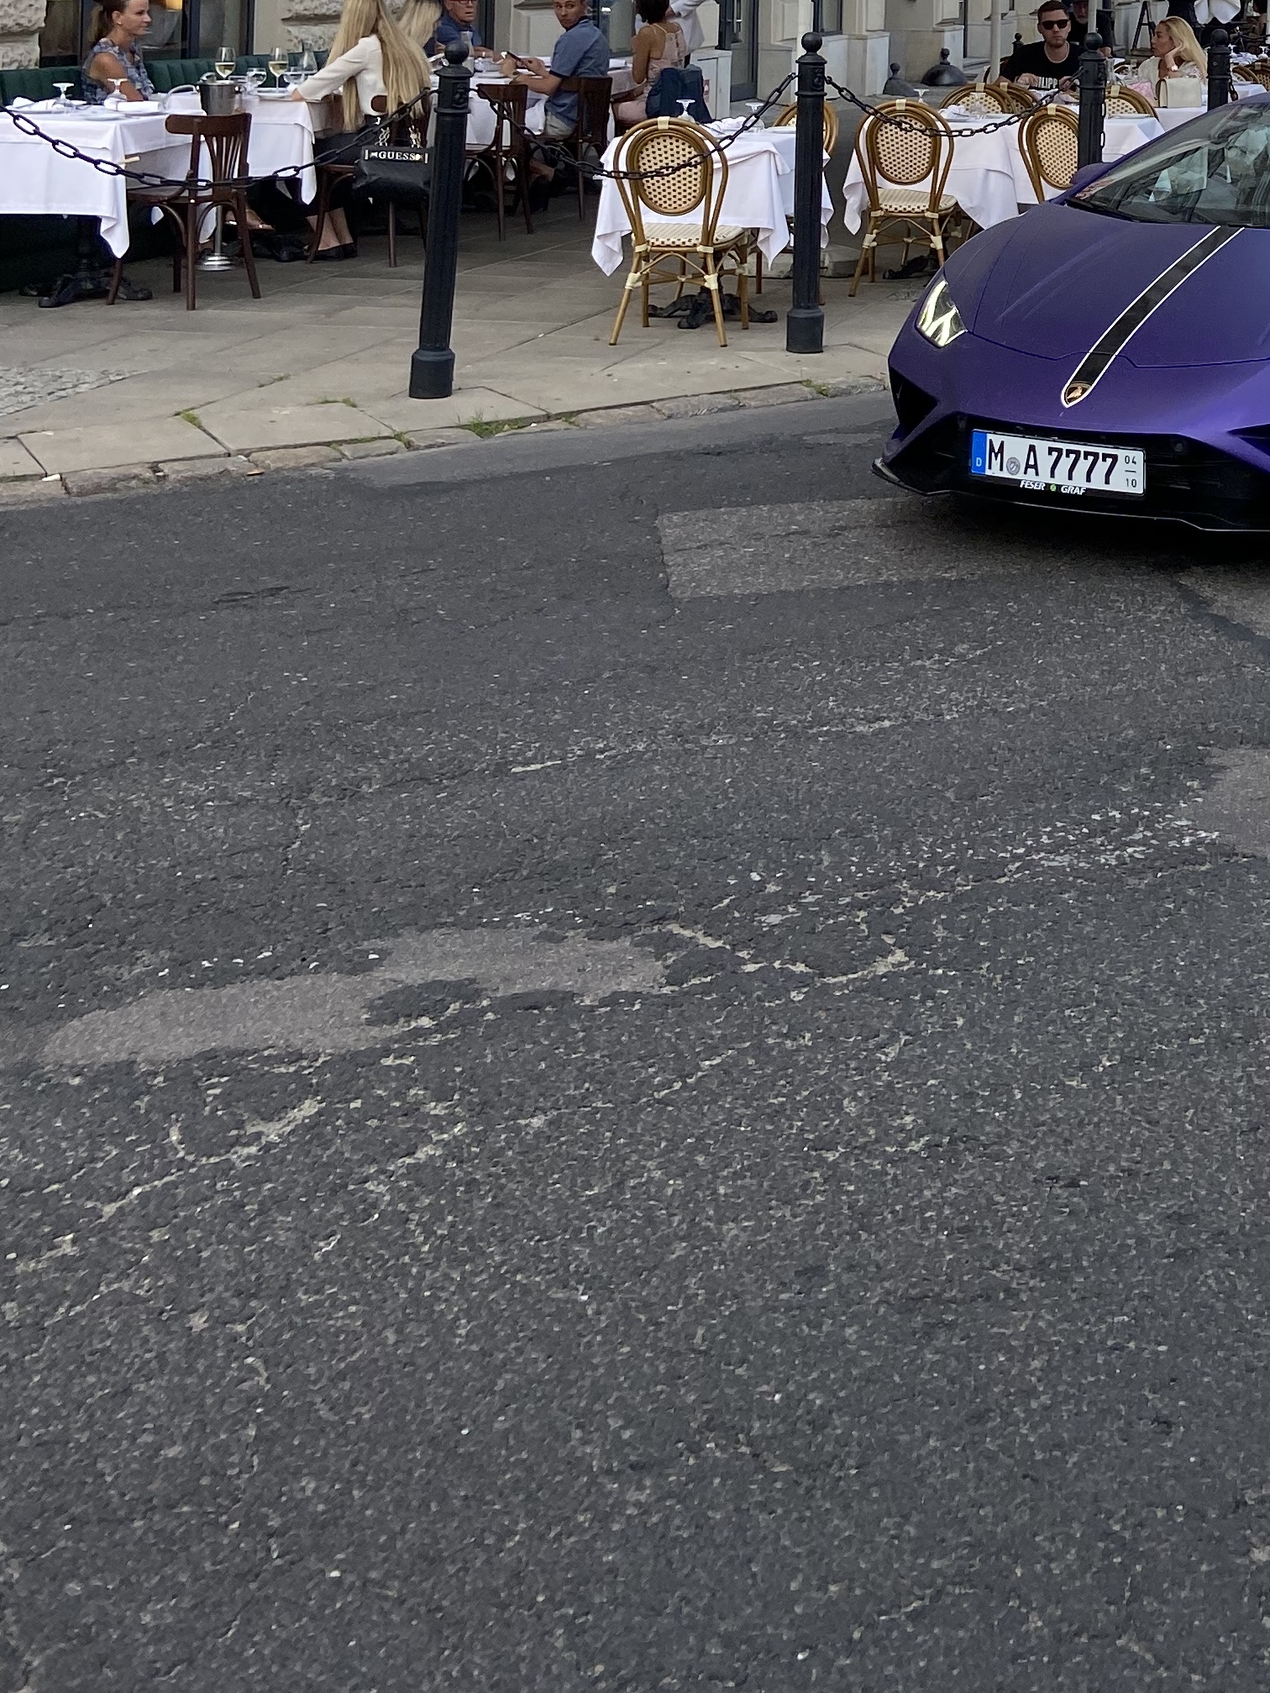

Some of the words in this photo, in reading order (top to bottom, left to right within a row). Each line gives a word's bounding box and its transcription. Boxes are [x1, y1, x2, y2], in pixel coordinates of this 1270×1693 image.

[378, 151, 416, 161] GUESS
[975, 457, 982, 467] D
[987, 438, 1005, 472] M
[1023, 444, 1039, 477] A
[1047, 446, 1119, 485] 7777
[1124, 455, 1137, 465] 04
[1019, 479, 1045, 491] FESER
[1060, 486, 1086, 496] GRAF
[1125, 478, 1137, 488] 10
